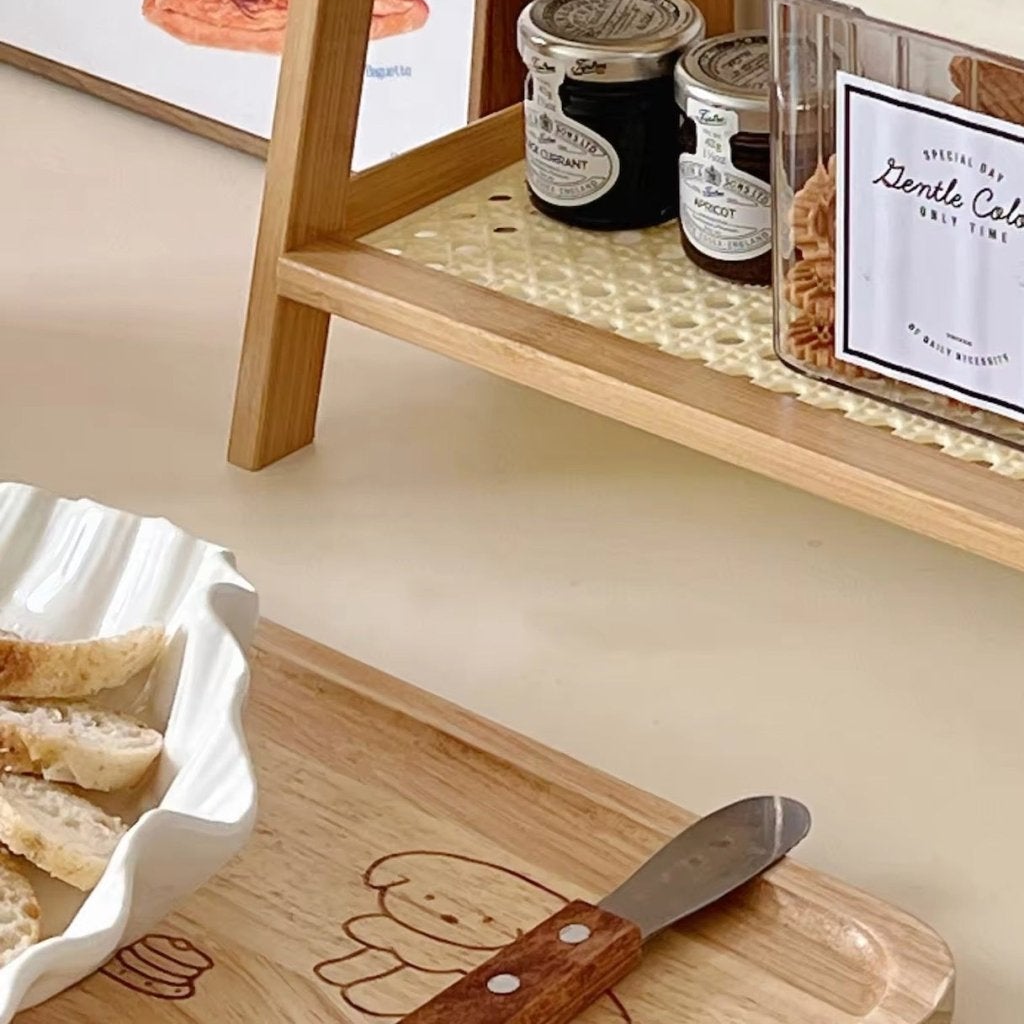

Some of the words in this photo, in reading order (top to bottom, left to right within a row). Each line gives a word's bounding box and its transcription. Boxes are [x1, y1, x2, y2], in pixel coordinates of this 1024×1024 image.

[873, 157, 964, 208] Gentle
[923, 149, 973, 168] SPECIAL
[979, 162, 1004, 182] DAY
[694, 197, 736, 219] APRICOT
[920, 206, 957, 227] ONLY
[969, 222, 1008, 244] TIME
